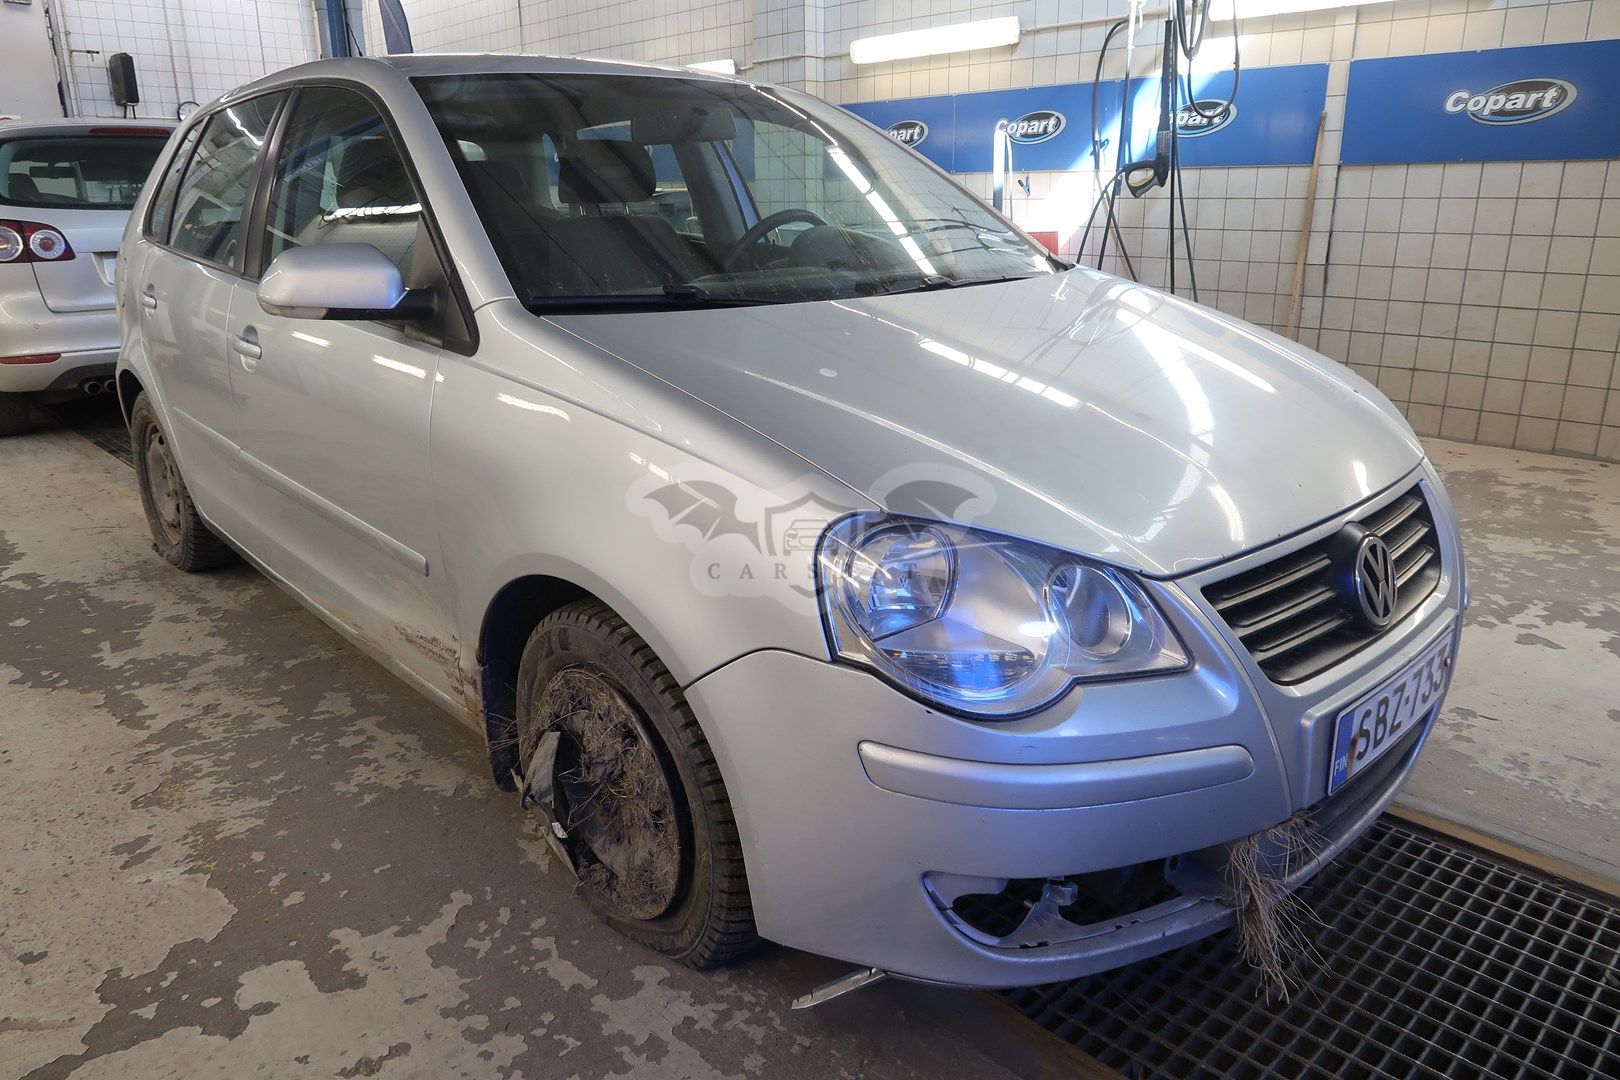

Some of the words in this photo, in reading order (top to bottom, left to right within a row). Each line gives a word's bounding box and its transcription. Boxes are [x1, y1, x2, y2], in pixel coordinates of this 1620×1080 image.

[1445, 84, 1561, 116] Copart
[886, 125, 921, 141] part
[995, 118, 1058, 138] Copart
[1356, 643, 1448, 761] SBZ-733
[1334, 754, 1349, 776] FIN
